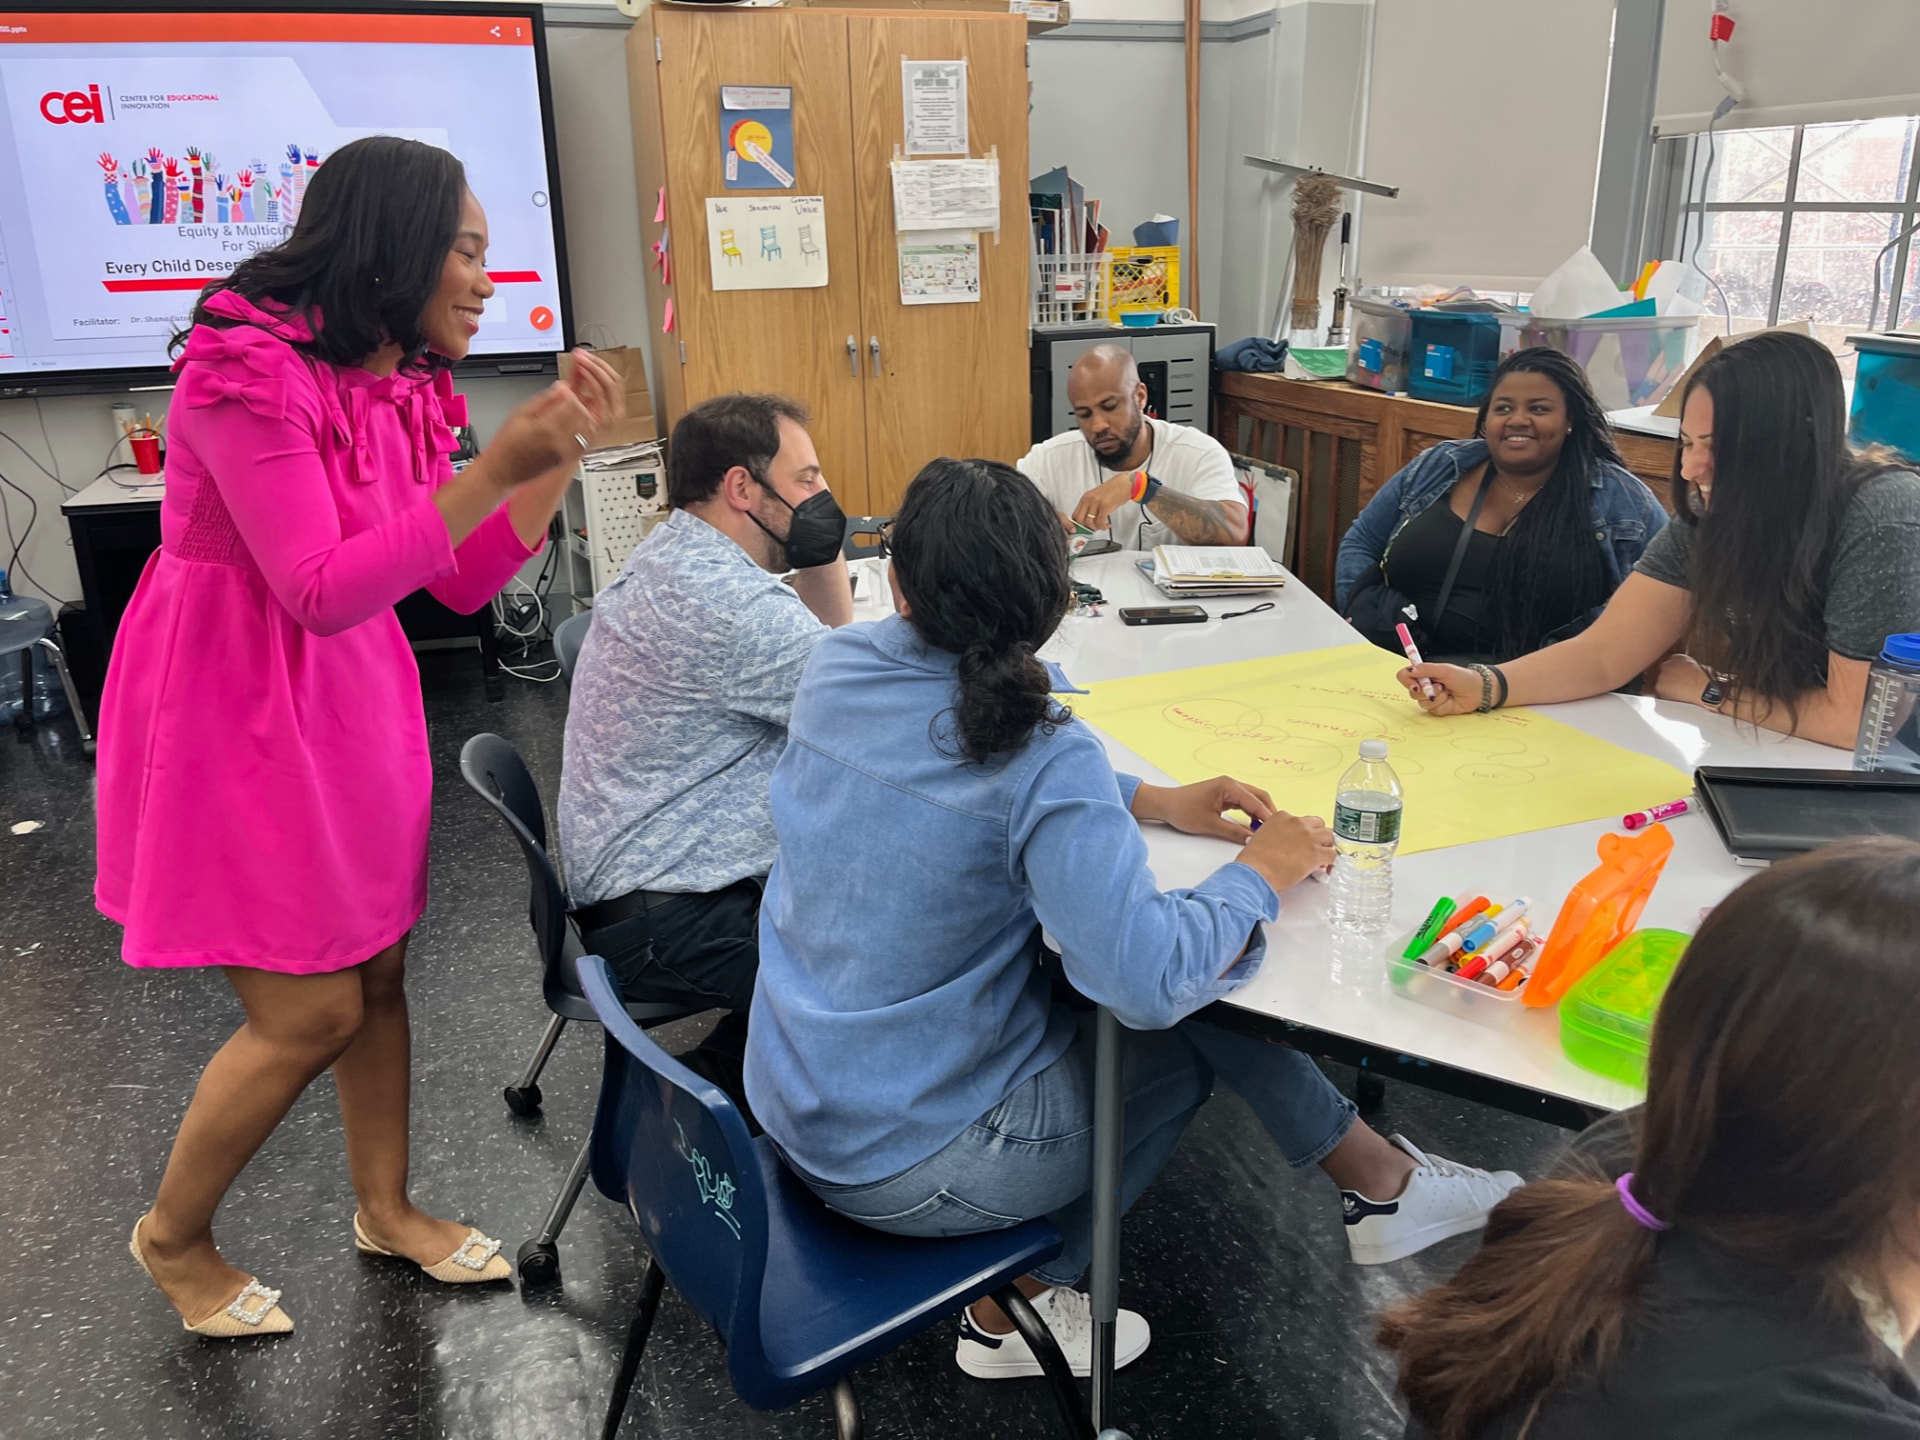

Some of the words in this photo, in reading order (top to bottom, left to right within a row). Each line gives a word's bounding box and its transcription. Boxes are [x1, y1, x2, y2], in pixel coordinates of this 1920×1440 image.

[150, 94, 165, 102] FOR
[166, 93, 220, 102] EDUCATIONAL
[39, 83, 105, 125] cei
[121, 102, 171, 110] INNOVATION
[178, 225, 220, 239] Equity
[223, 225, 232, 236] &
[222, 241, 243, 251] For
[105, 261, 148, 276] Every
[152, 259, 191, 273] Child
[73, 318, 121, 327] Facilitator:
